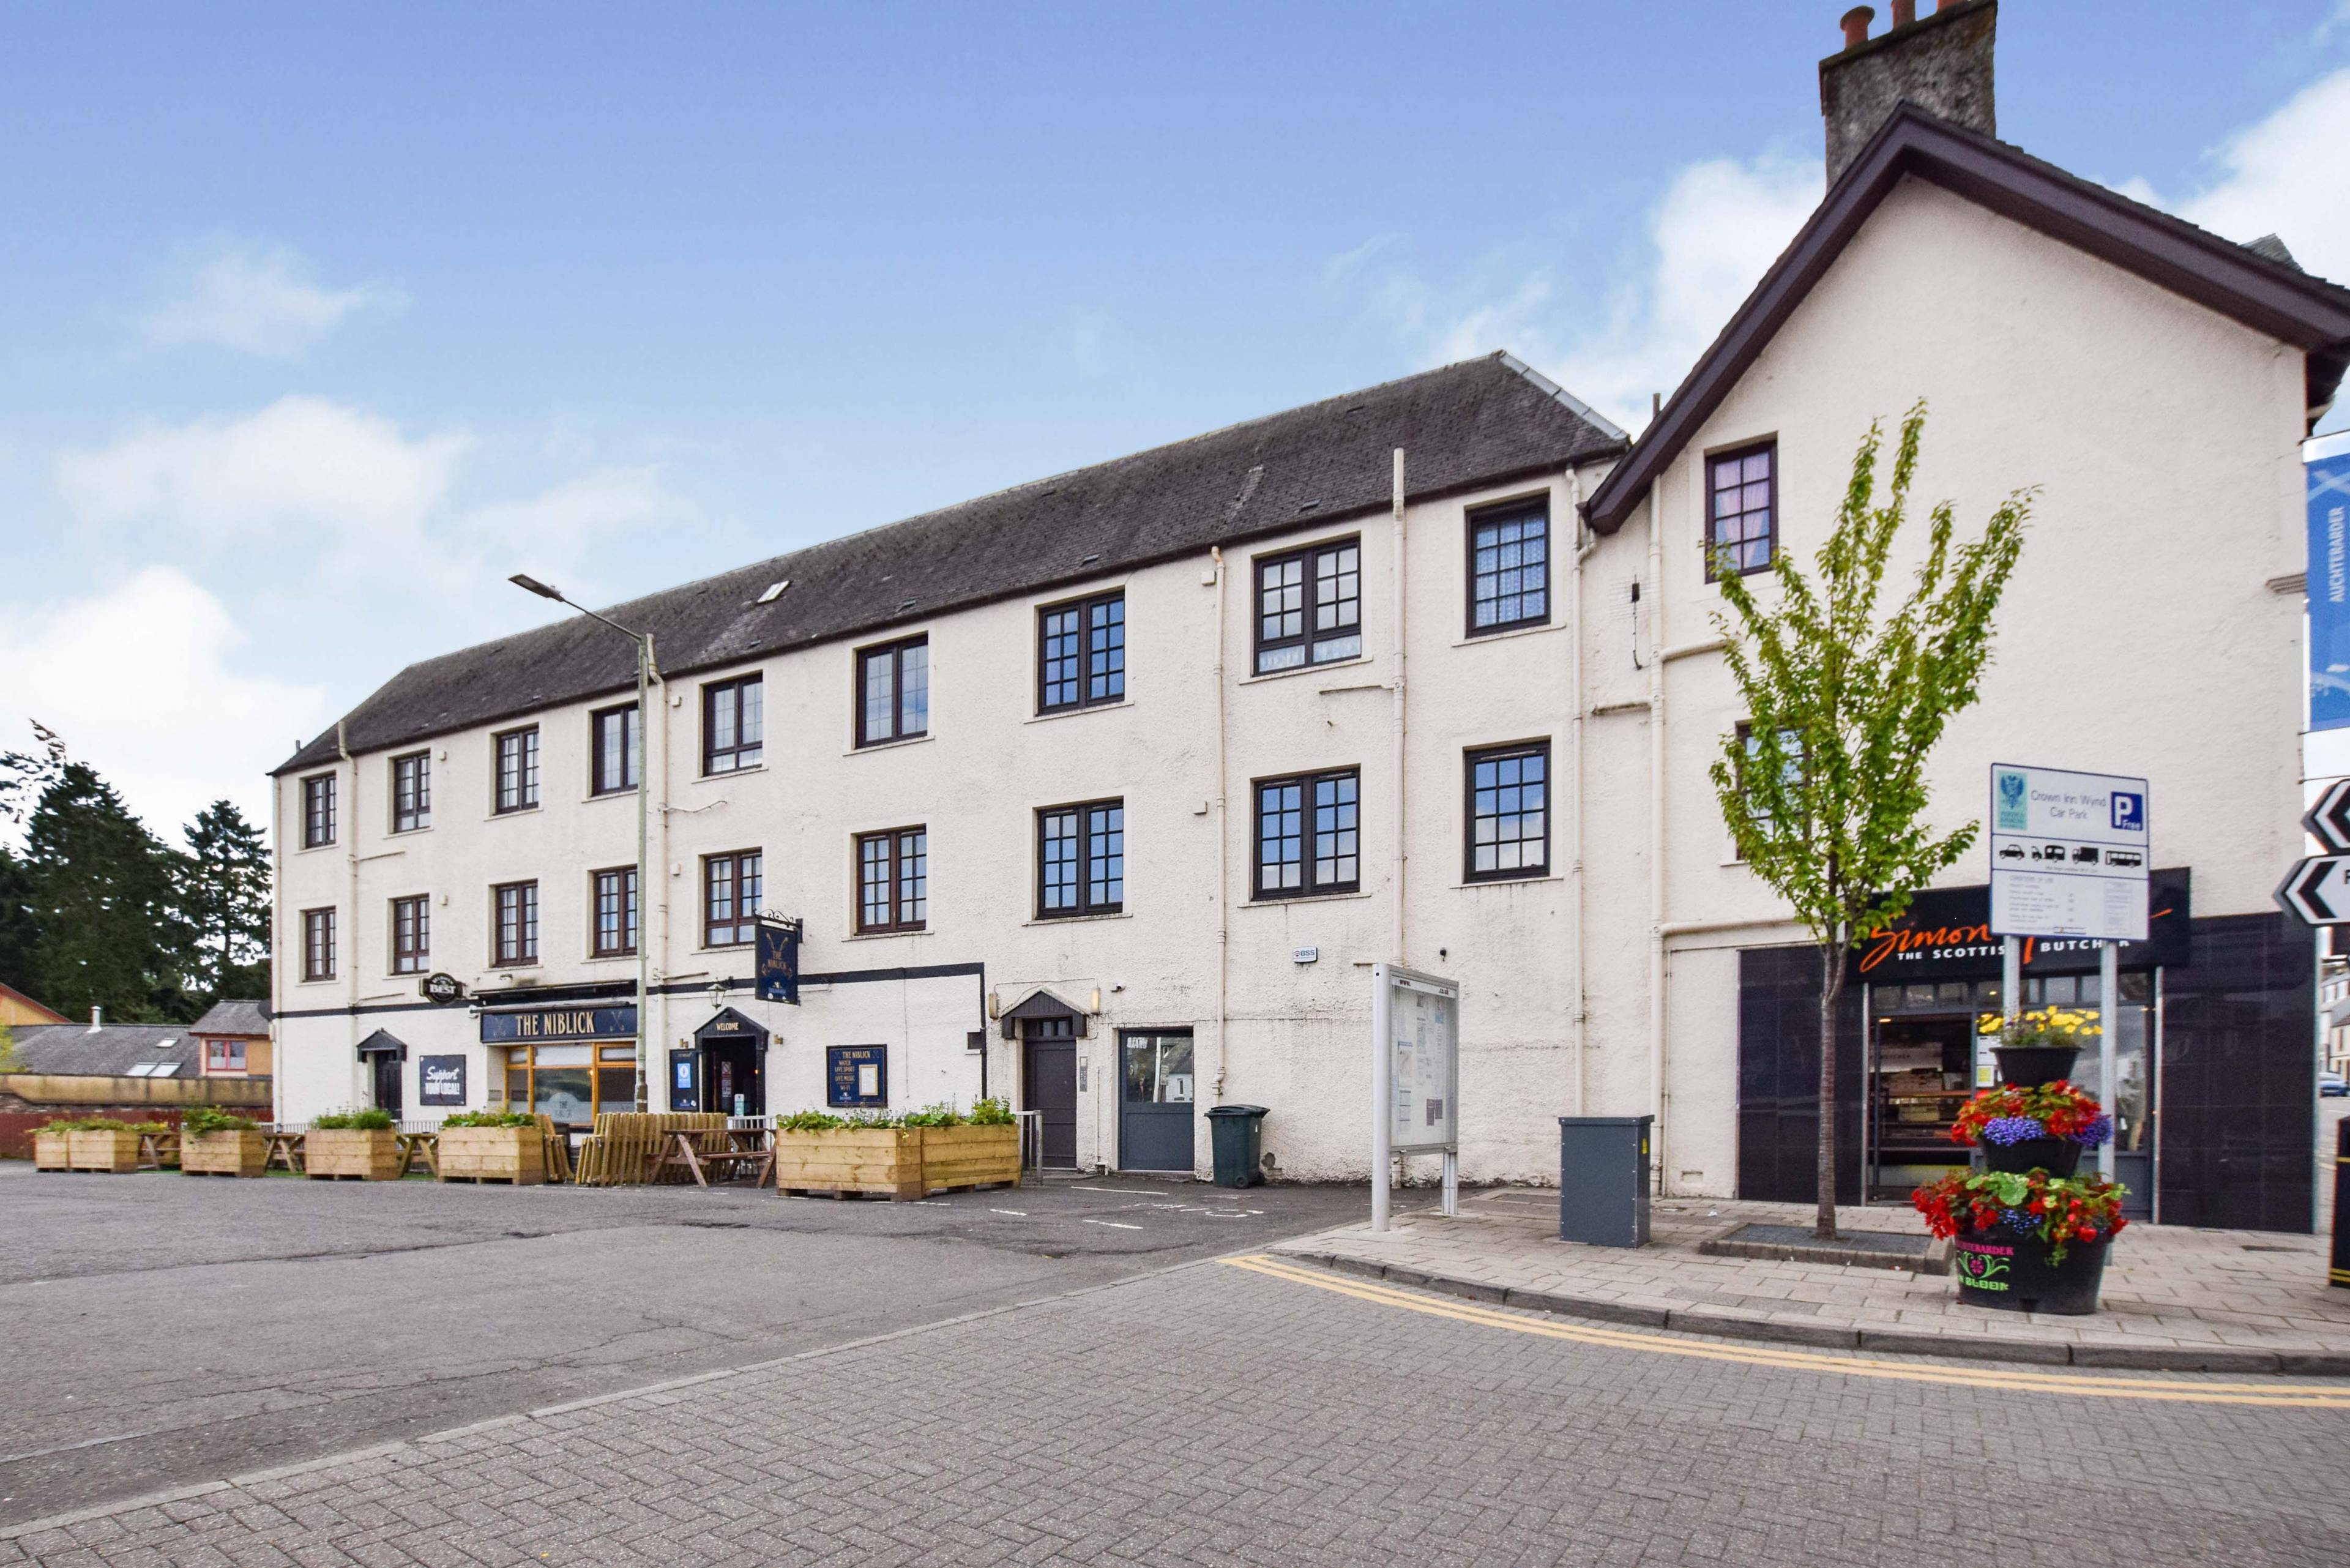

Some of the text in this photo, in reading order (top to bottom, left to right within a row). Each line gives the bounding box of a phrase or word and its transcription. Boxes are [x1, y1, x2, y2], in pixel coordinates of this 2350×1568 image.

[2031, 790, 2106, 808] Crown Inn Wynd
[2050, 807, 2087, 819] Car Park
[2114, 796, 2133, 826] P
[2122, 820, 2141, 831] Free
[2040, 939, 2130, 952] BUTCHR
[1898, 946, 2005, 960] THE SCOTTIS
[430, 984, 456, 994] BEST
[515, 1012, 595, 1036] THE NIBLICK
[426, 1066, 460, 1083] Support
